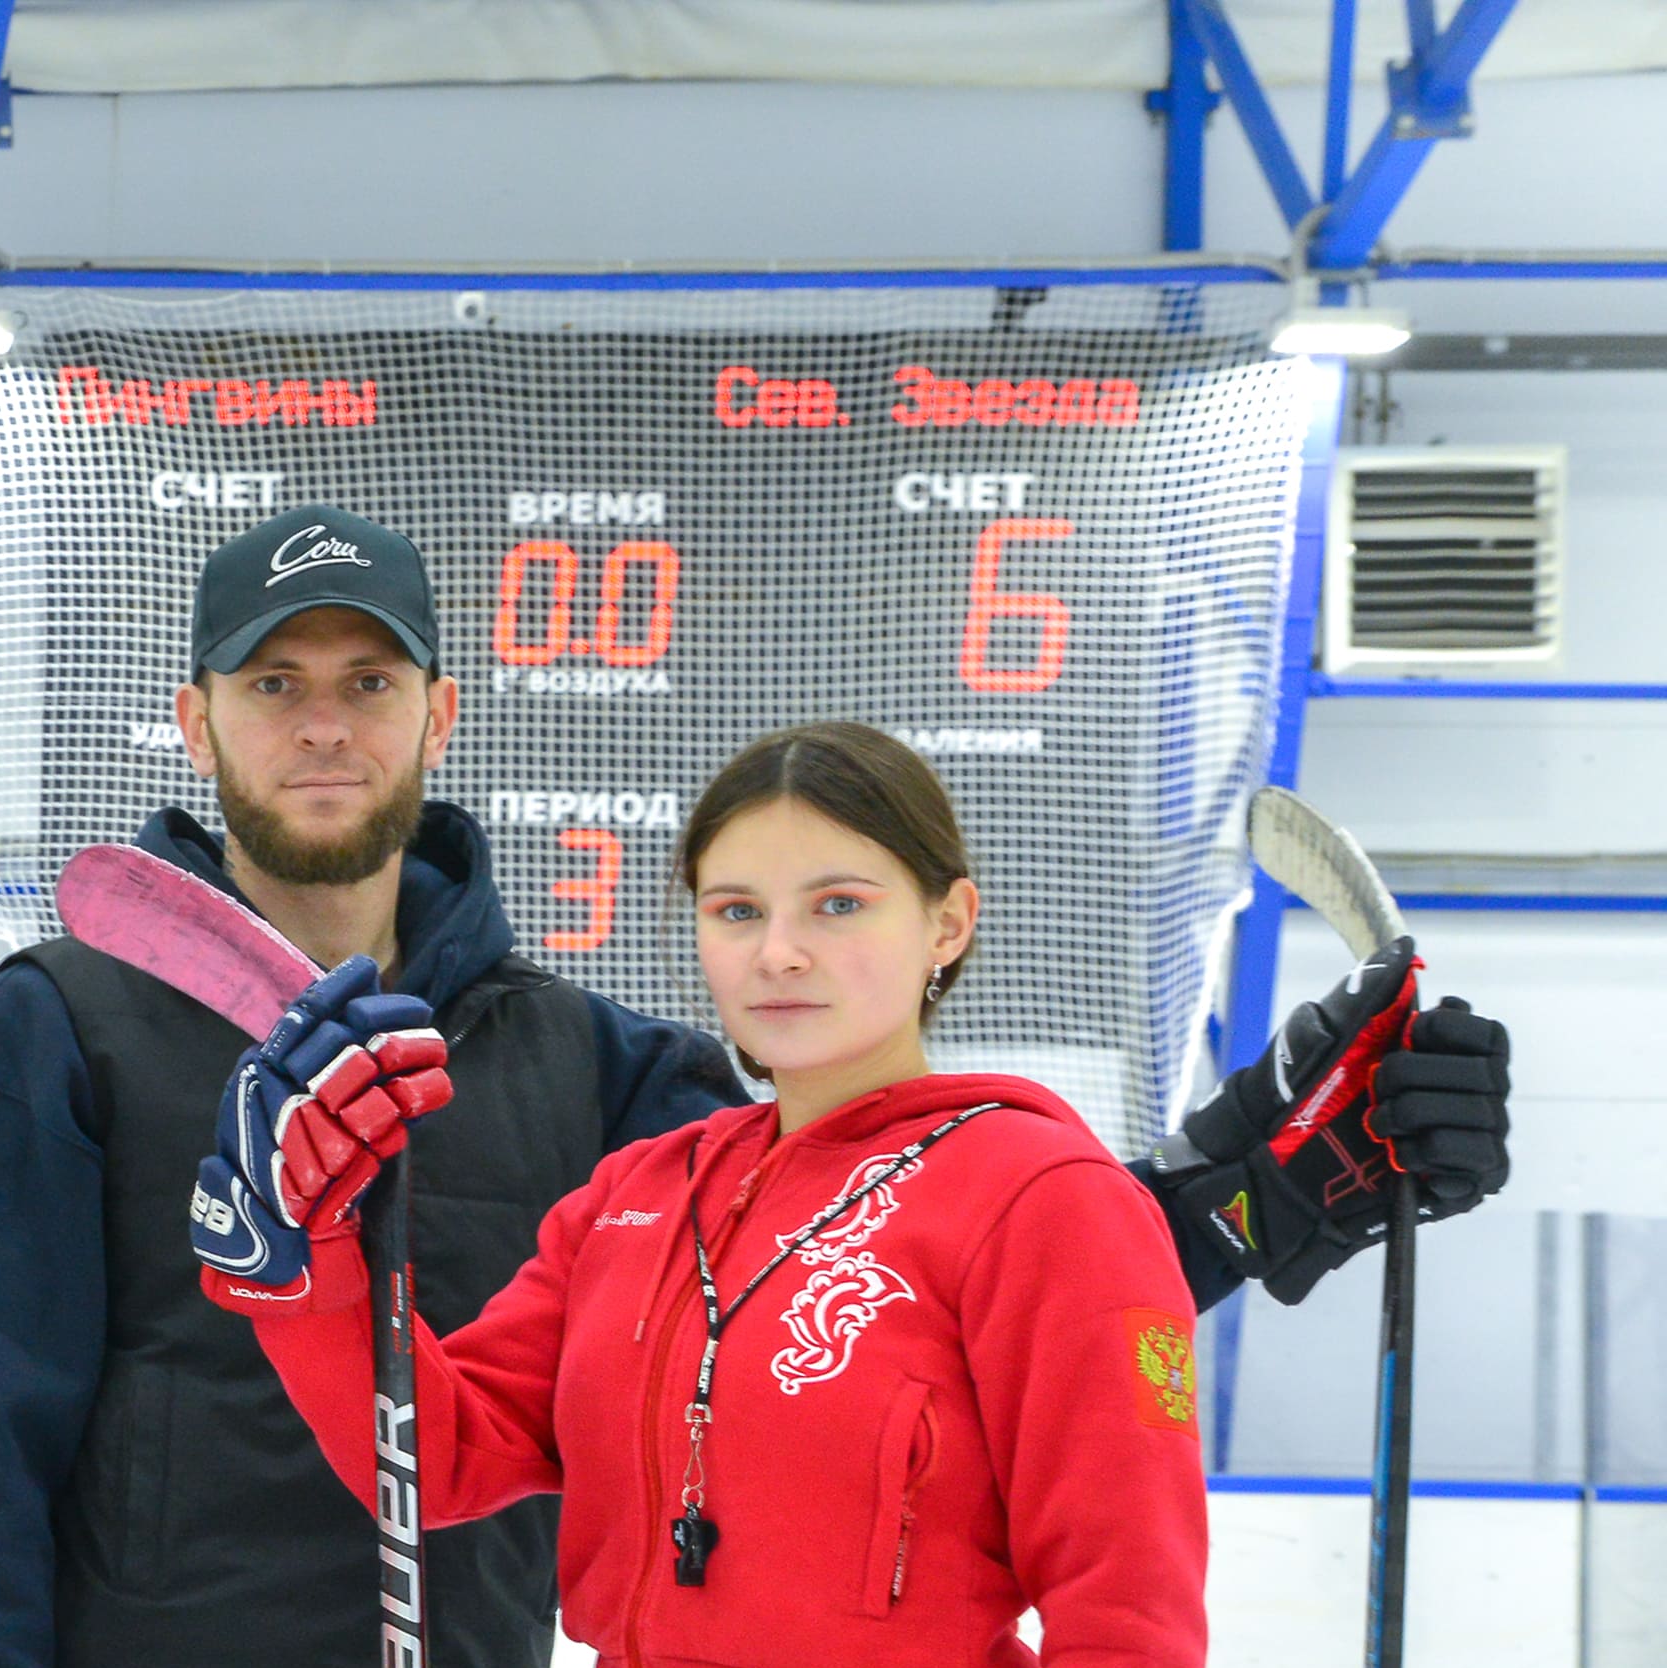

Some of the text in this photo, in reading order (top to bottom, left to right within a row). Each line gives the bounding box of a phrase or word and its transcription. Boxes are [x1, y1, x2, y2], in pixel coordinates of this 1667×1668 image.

[151, 472, 284, 510] СЧЕТ
[509, 491, 665, 524] ВРЕМЯ
[894, 472, 1035, 512] СЧЕТ
[493, 540, 679, 666] 0.0
[957, 517, 1075, 692] 6
[528, 671, 670, 695] ВОЗДУХА
[489, 792, 678, 829] ПЕРИОД
[543, 828, 622, 951] 3
